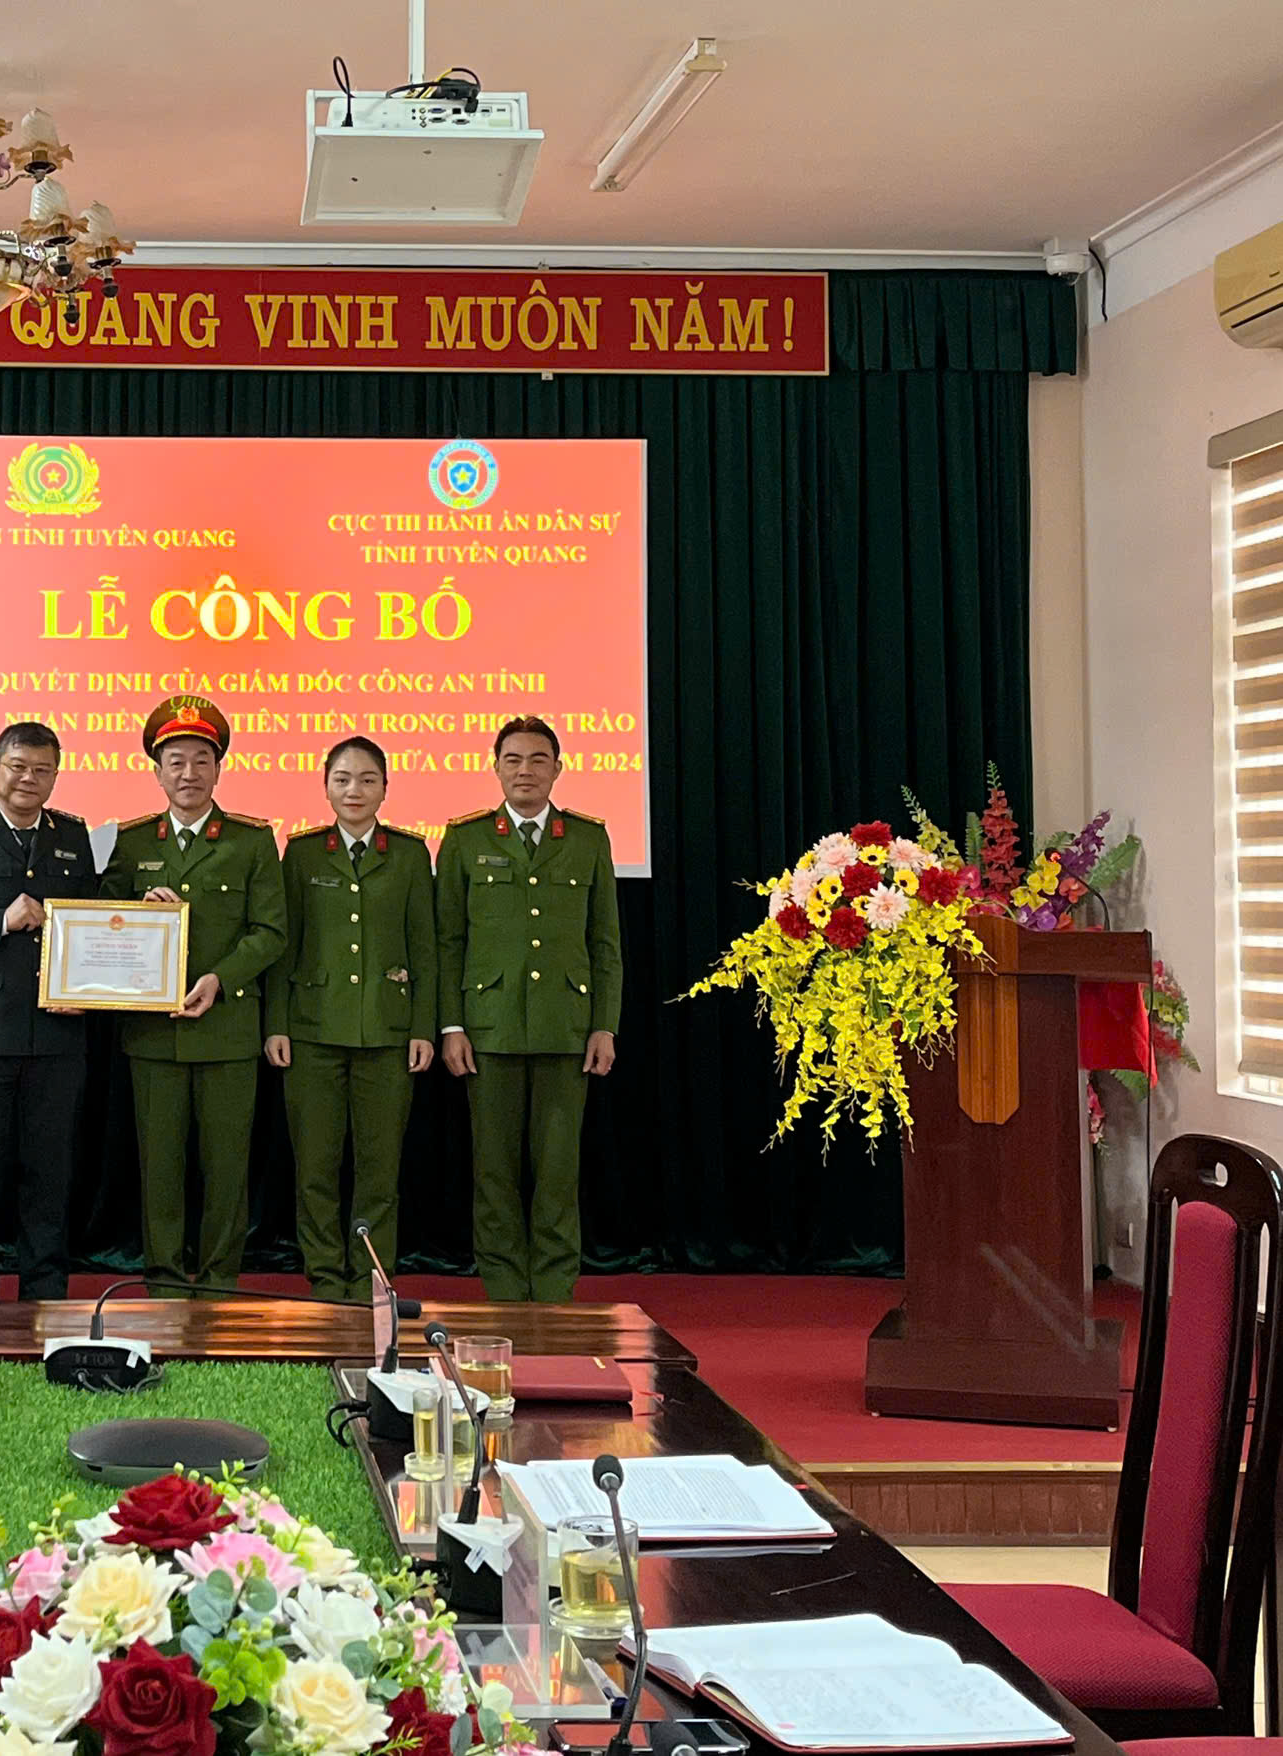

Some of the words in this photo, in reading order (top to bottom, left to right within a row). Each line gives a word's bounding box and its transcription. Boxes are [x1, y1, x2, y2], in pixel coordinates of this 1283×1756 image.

[11, 291, 221, 349] QUANG
[245, 295, 399, 350] VINH
[426, 279, 603, 352] MUÔN
[328, 514, 375, 536] CỤC
[381, 514, 421, 531] THI
[427, 510, 492, 532] HÀNH
[537, 509, 583, 531] DÂN
[589, 511, 621, 536] SỰ
[8, 522, 64, 545] TỈNH
[70, 523, 147, 546] TUYÊN
[153, 530, 236, 550] QUANG
[422, 541, 498, 563] TUYÊN
[504, 546, 587, 566] QUANG
[38, 575, 128, 640] LỄ
[150, 575, 355, 641] CÔNG
[374, 577, 472, 641] BỐ
[219, 668, 289, 693] GIÁM
[358, 669, 434, 693] CÔNG
[440, 673, 474, 693] AN
[481, 668, 545, 693] TỈNH
[229, 708, 290, 732] TIÊN
[363, 713, 455, 733] TRONG
[561, 708, 636, 733] TRÀO
[60, 752, 119, 771] HAM
[386, 748, 437, 771] HỮA
[591, 752, 642, 772] 2024
